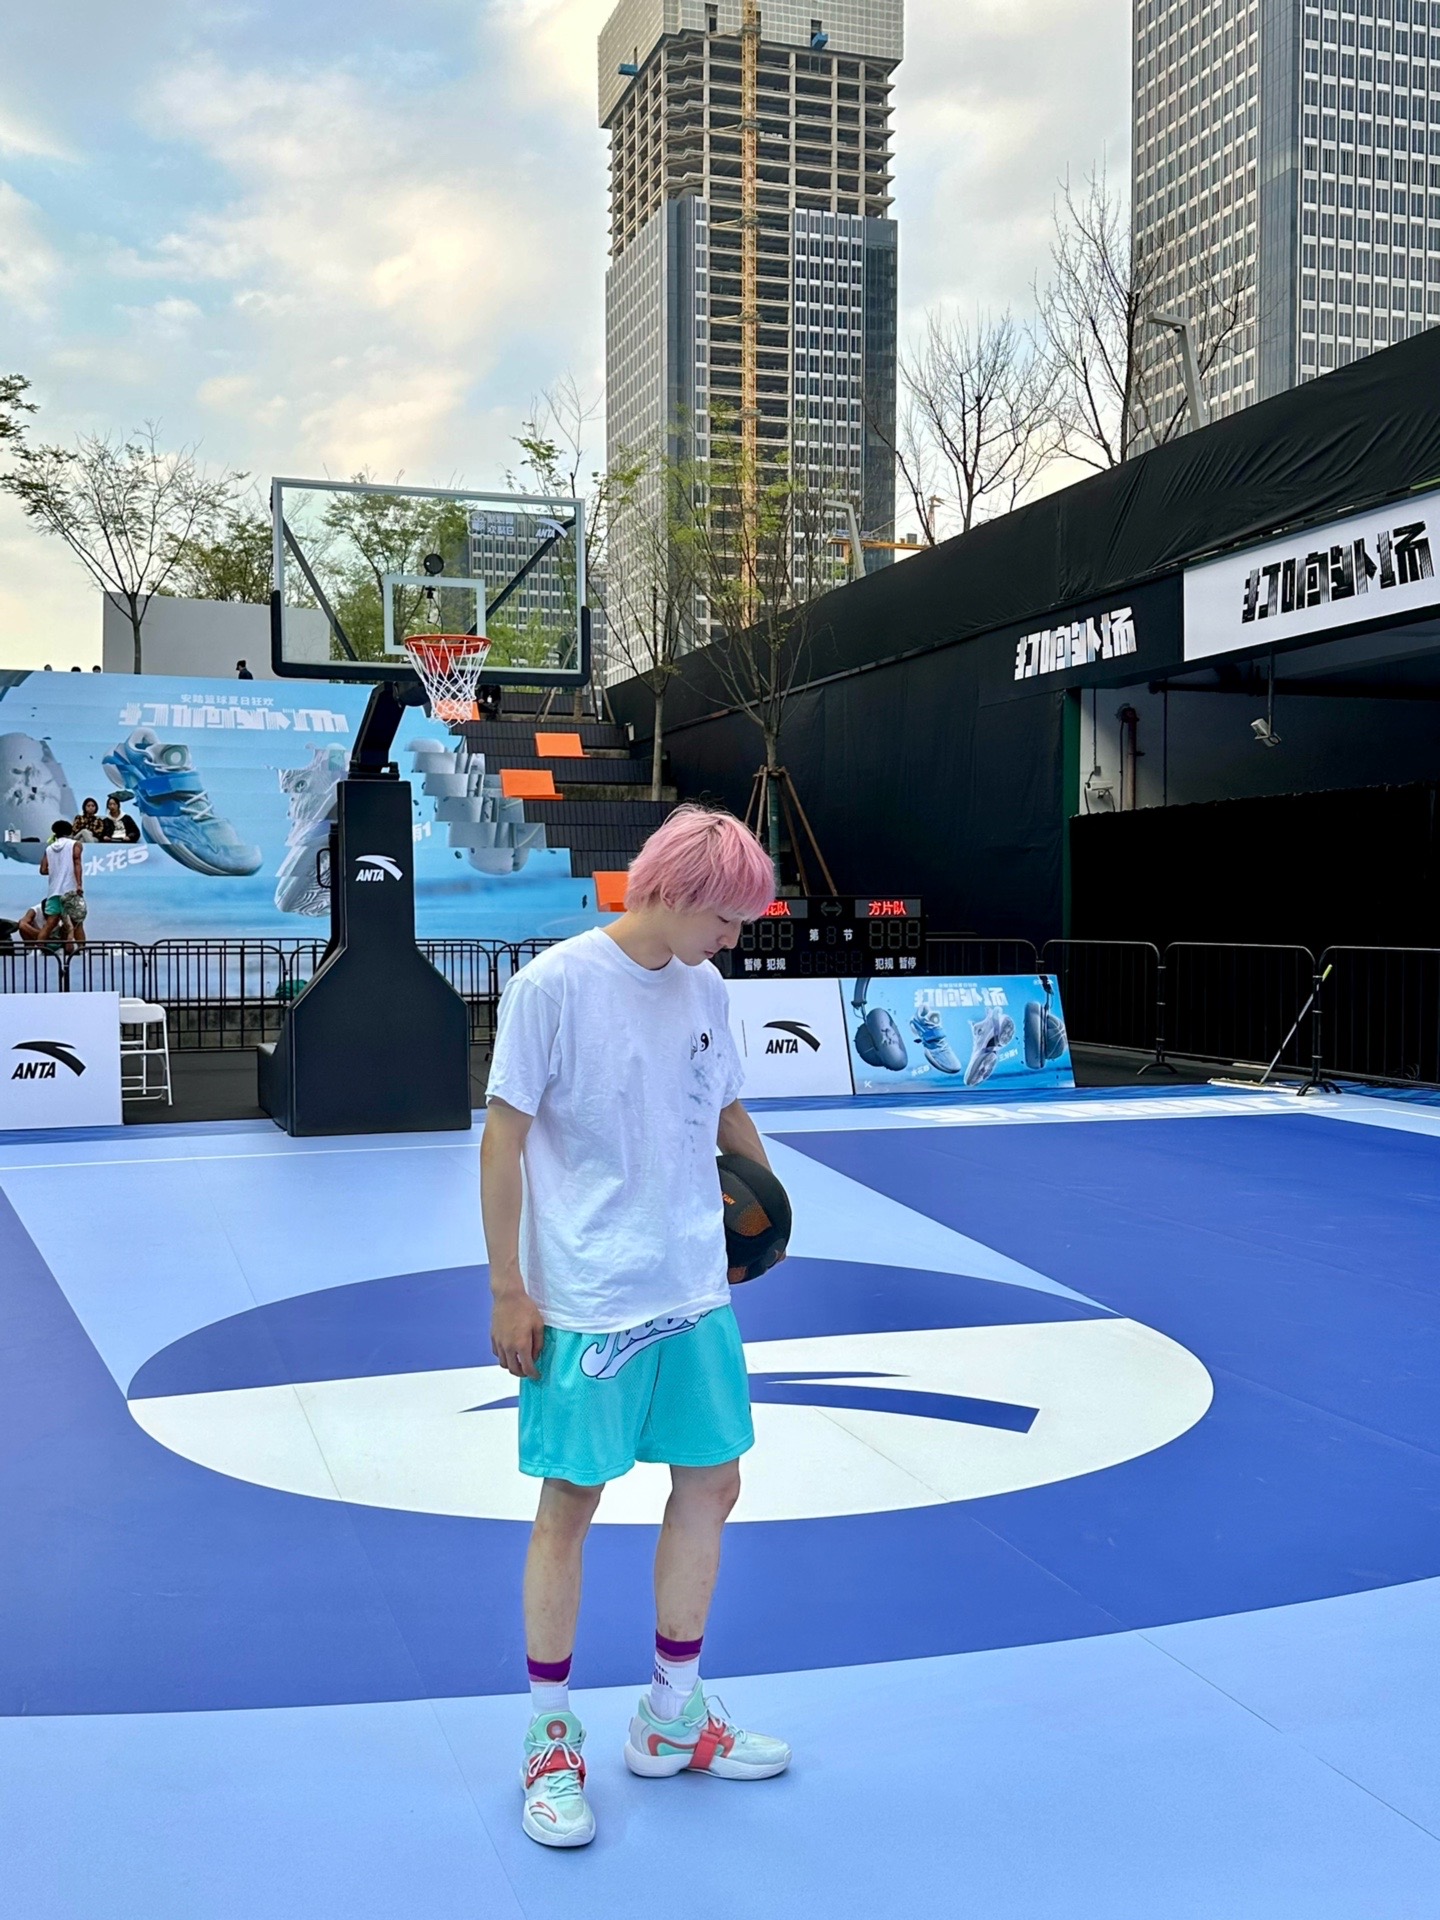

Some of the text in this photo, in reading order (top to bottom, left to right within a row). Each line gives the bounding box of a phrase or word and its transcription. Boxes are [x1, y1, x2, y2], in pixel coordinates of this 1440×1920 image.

[1241, 520, 1435, 623] 打响外场
[1013, 605, 1137, 681] 打响外场
[181, 694, 274, 707] 安踏篮球夏日狂欢
[84, 845, 149, 876] 水花5
[355, 868, 386, 882] ANTA
[764, 901, 791, 916] 花队
[868, 900, 907, 916] 方片队
[809, 929, 854, 942] 第 节
[744, 958, 787, 971] 暂停 犯规
[875, 957, 916, 971] 犯规 暂停
[765, 1039, 799, 1055] ANTA
[11, 1063, 56, 1080] ANTA
